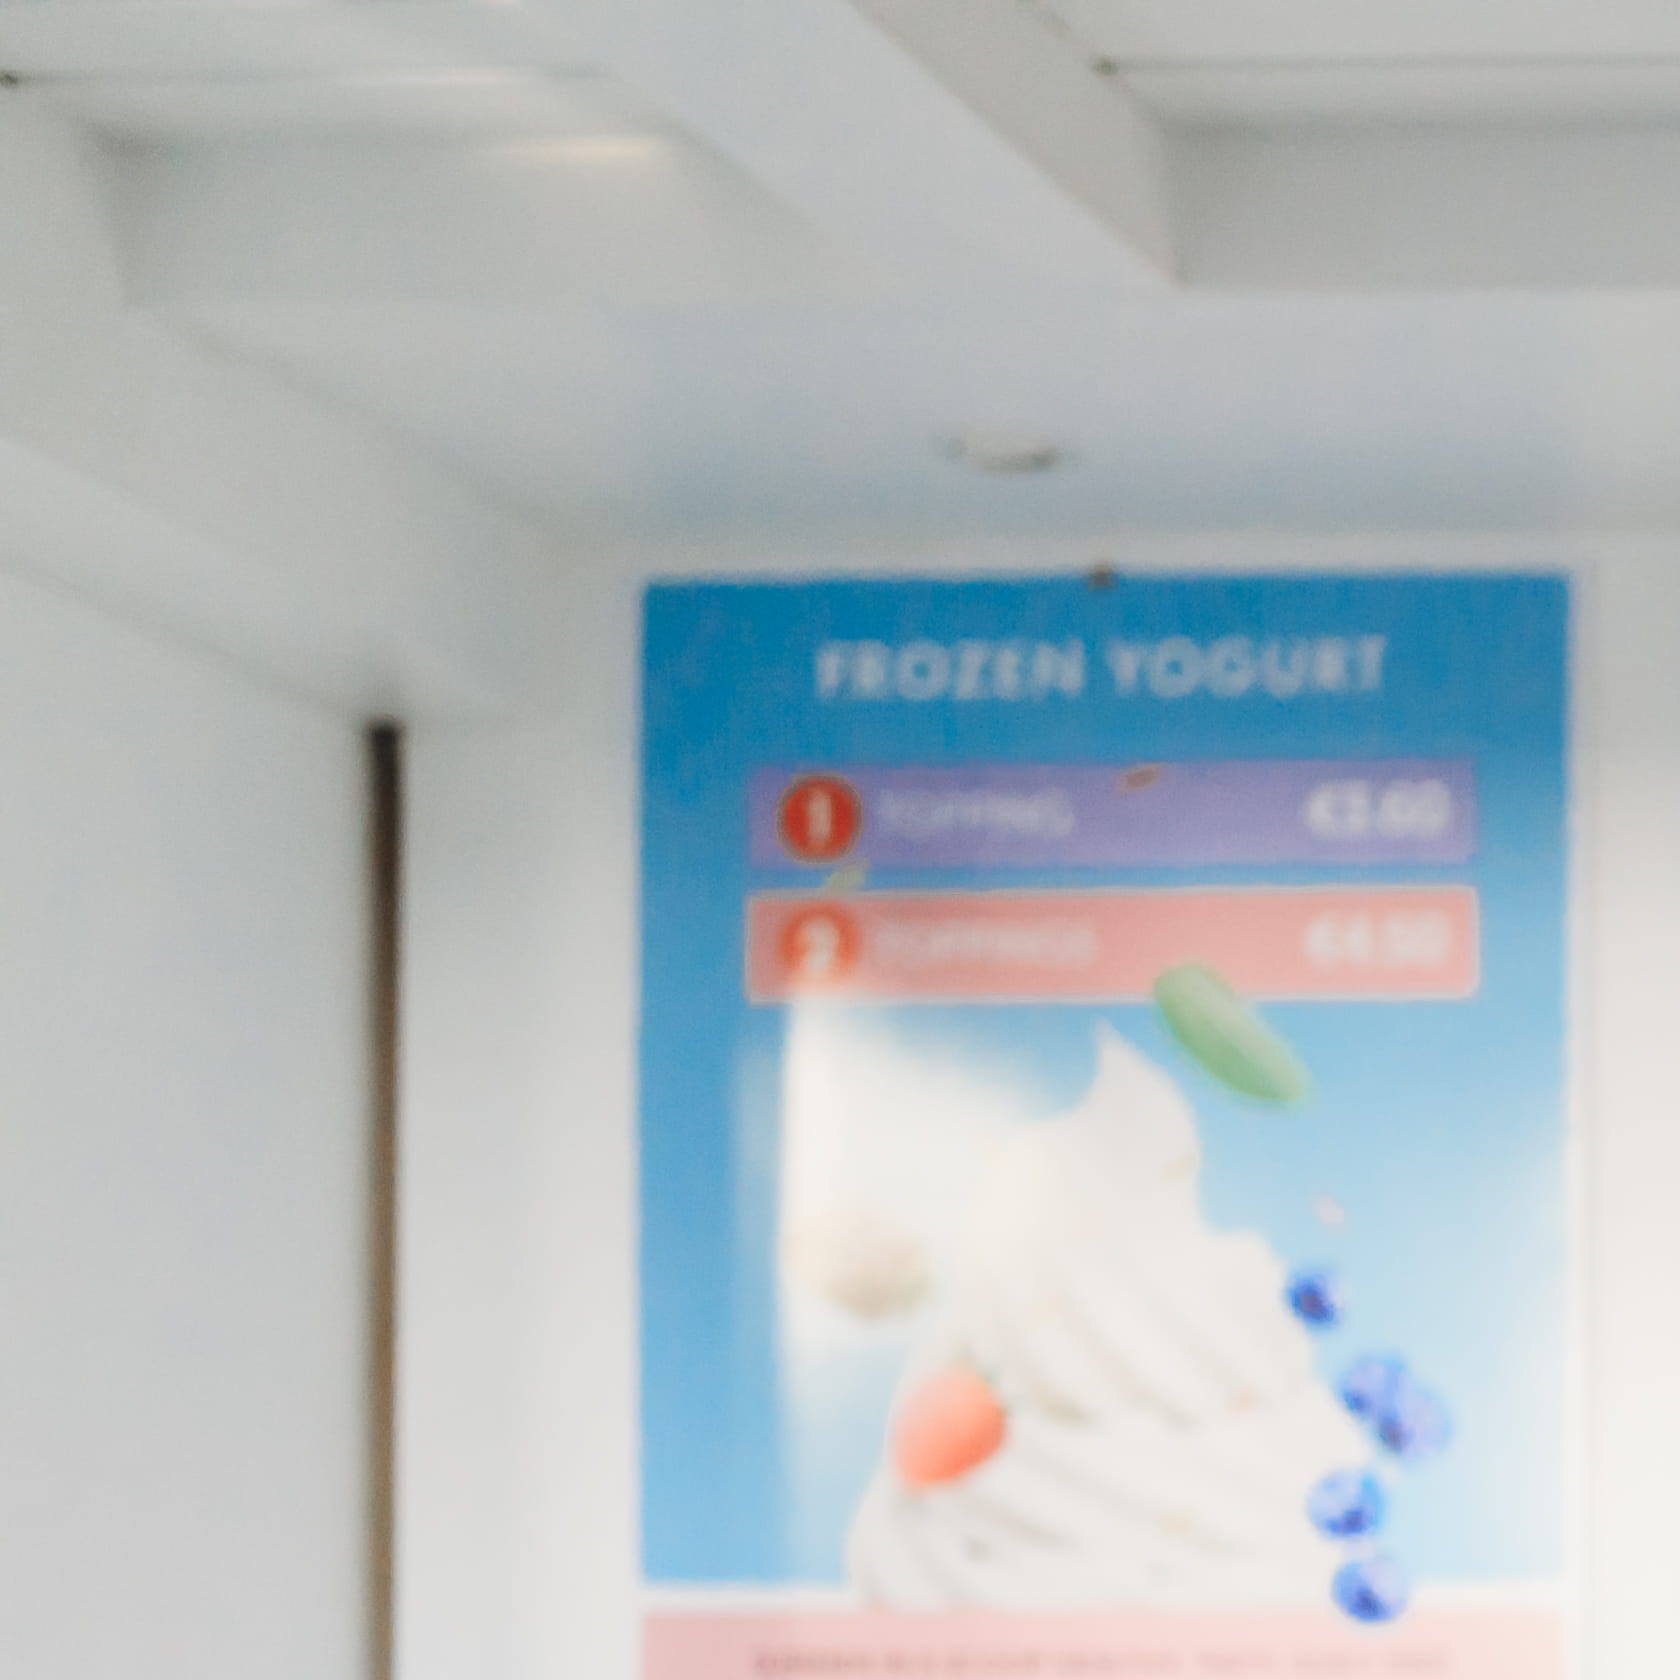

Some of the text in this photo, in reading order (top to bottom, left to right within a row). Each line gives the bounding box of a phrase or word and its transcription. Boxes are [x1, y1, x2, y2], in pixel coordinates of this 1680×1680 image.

[813, 634, 1386, 699] FROZEN YOGURT
[807, 789, 833, 850] 1
